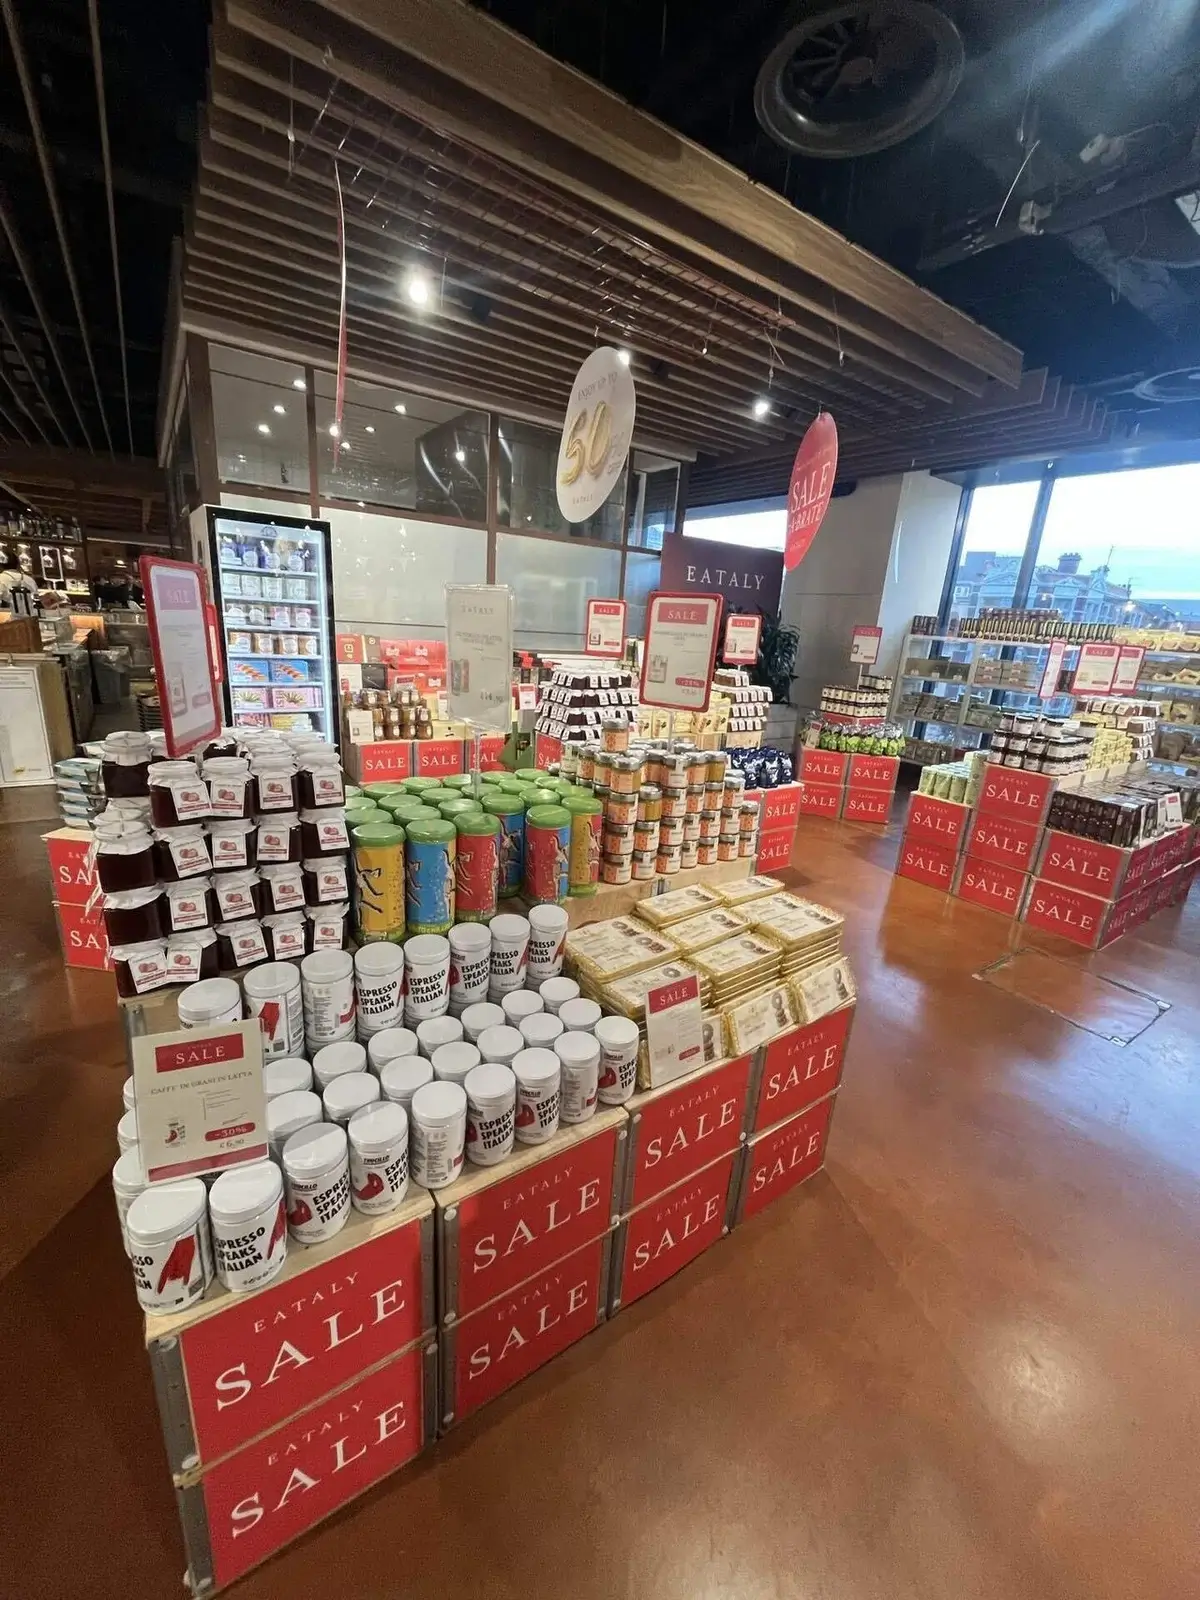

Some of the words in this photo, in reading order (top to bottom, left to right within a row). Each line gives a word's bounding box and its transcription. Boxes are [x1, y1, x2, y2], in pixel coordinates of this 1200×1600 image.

[790, 461, 831, 514] SALE
[685, 565, 764, 590] EATALY
[667, 610, 698, 620] SALE
[365, 757, 406, 771] SALE
[422, 754, 459, 767] SALE
[472, 751, 497, 763] SAL
[805, 762, 841, 776] SALE
[854, 767, 890, 781] SALE
[801, 794, 837, 807] SALE
[849, 800, 886, 813] SALE
[986, 784, 1040, 808] SALE
[766, 802, 797, 818] SALE
[912, 811, 957, 835] SALE
[760, 843, 790, 860] SALE
[975, 830, 1028, 856] SALE
[59, 865, 92, 886] SA
[905, 852, 949, 877] SALE
[1050, 852, 1111, 882] SALE
[965, 873, 1016, 901] SALE
[1034, 899, 1094, 930] SALE
[70, 930, 102, 950] SA
[359, 980, 398, 998] ESPRESSO
[409, 969, 446, 986] ESPRESSO
[411, 981, 441, 996] SPEAKS
[360, 993, 392, 1006] SPEAKS
[362, 1000, 395, 1015] ITALIAN
[412, 988, 444, 1004] ITALIAN
[660, 986, 689, 1006] SALE
[175, 1046, 225, 1065] SALE
[227, 1070, 253, 1081] LATTA
[766, 1045, 837, 1101] SALE
[669, 1084, 720, 1118] EATALY
[214, 1126, 248, 1138] -30%
[645, 1098, 736, 1169] SALE
[753, 1131, 820, 1193] SALE
[503, 1166, 574, 1210] EATALY
[656, 1187, 702, 1222] EATALY
[473, 1178, 600, 1273] SALE
[633, 1194, 720, 1272] SALE
[254, 1272, 359, 1333] EATALY
[498, 1274, 562, 1321] EATALY
[469, 1280, 588, 1380] SALE
[215, 1280, 405, 1411] SALE
[268, 1400, 364, 1466] EATALY
[231, 1401, 406, 1538] SALE
